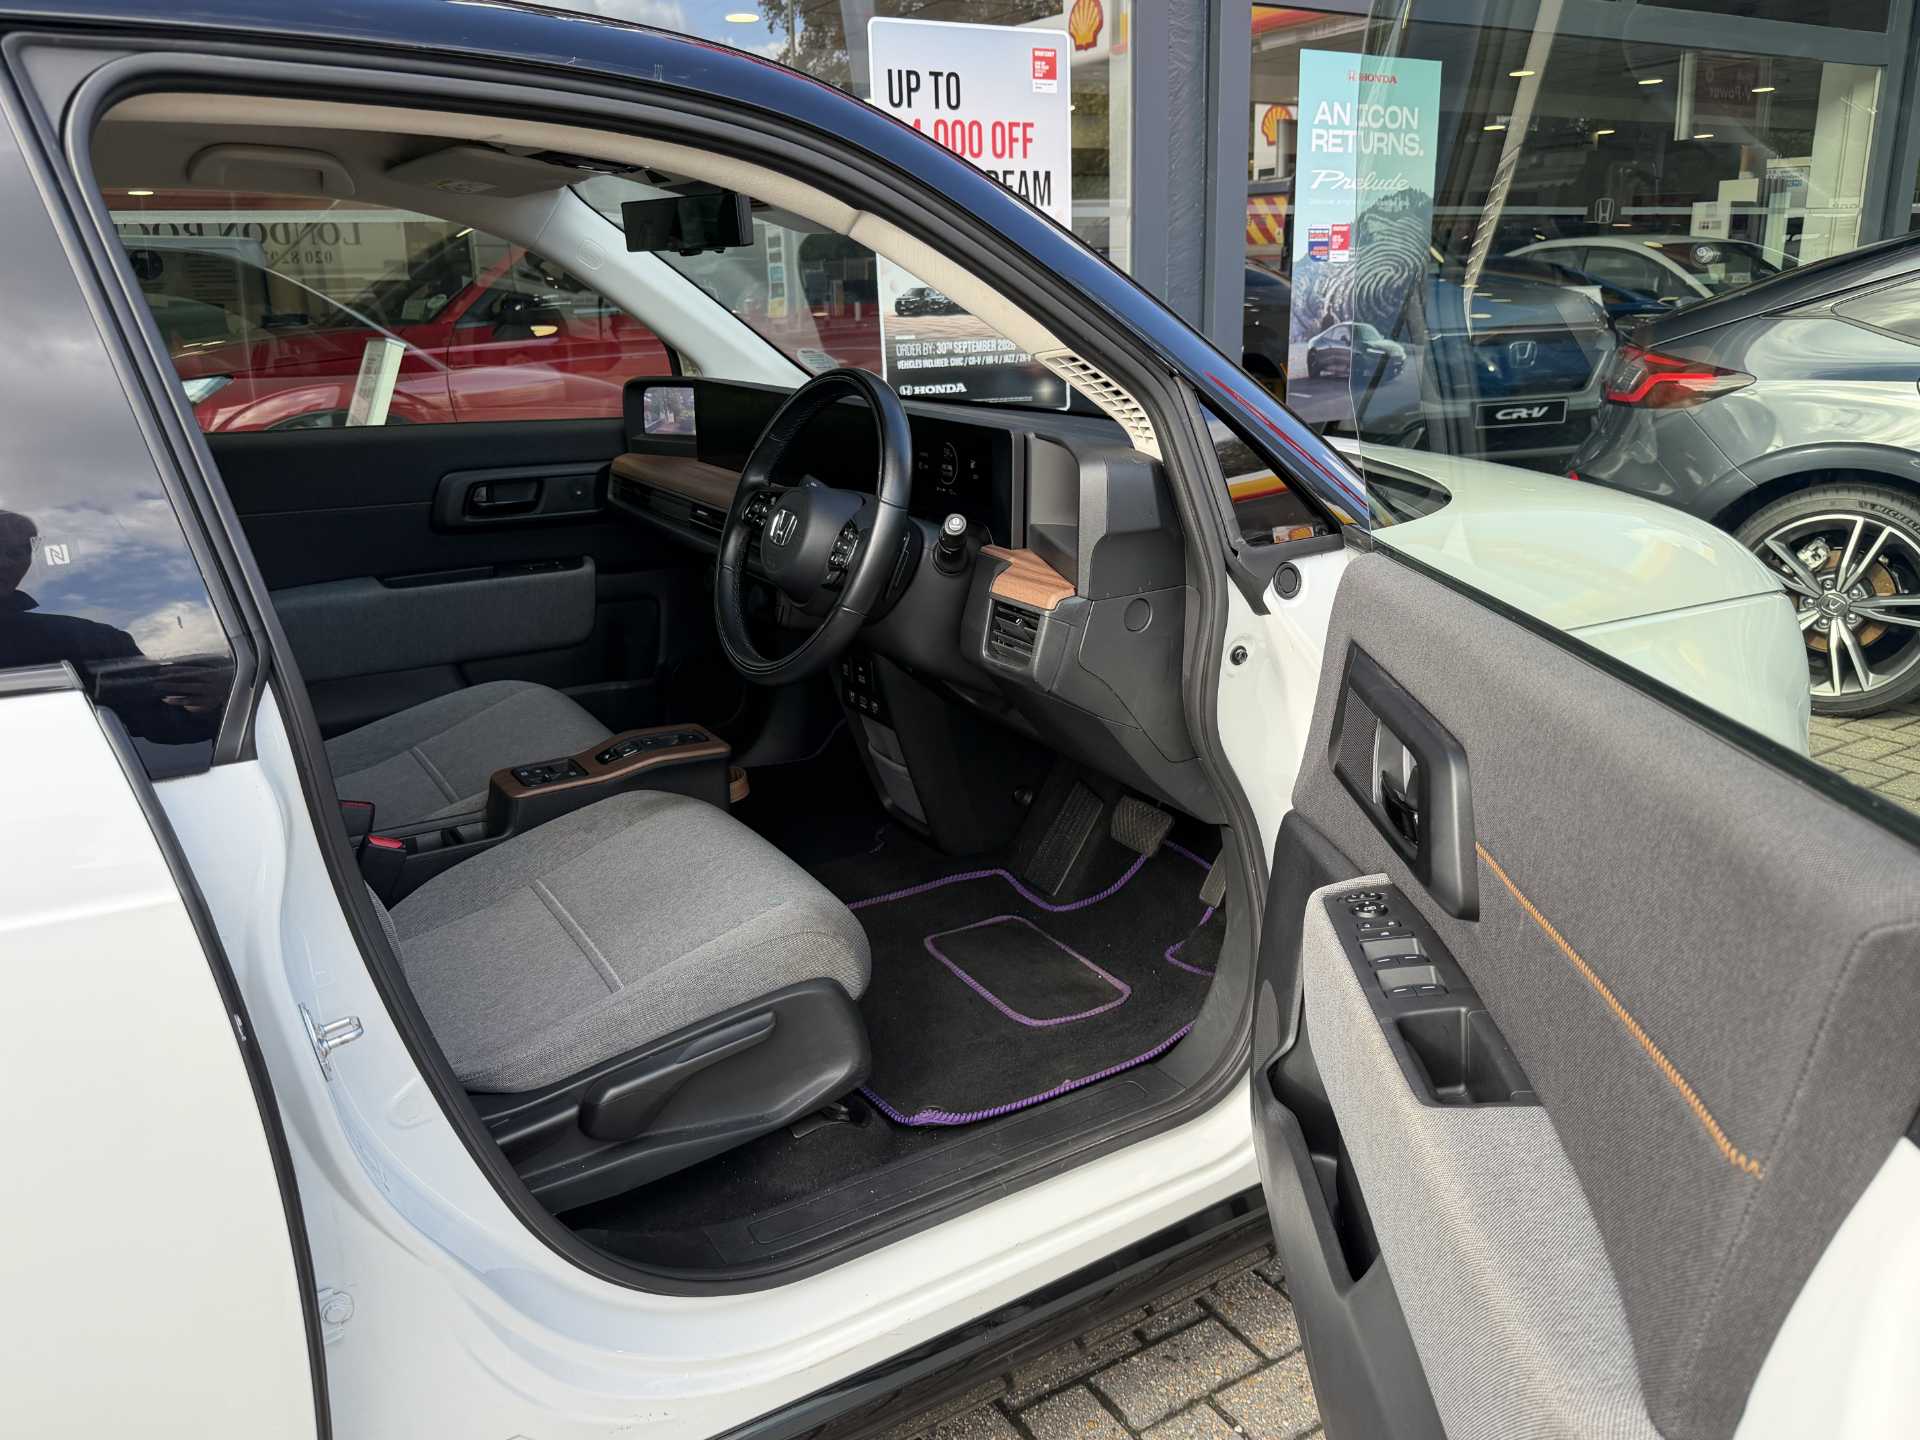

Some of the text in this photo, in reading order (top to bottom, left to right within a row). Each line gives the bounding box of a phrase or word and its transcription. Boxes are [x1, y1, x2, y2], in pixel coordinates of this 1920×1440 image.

[887, 68, 961, 110] UP TO
[1359, 73, 1397, 84] HONDA
[1313, 101, 1419, 130] AN ICON
[991, 121, 1034, 160] OFF
[1311, 129, 1424, 157] RETURNS.
[1310, 169, 1409, 192] Prelude
[896, 343, 921, 357] ORDER
[923, 342, 936, 356] BY:
[953, 339, 996, 354] SEPTEMBER
[914, 382, 967, 395] HONDA
[1495, 406, 1549, 420] CR-V
